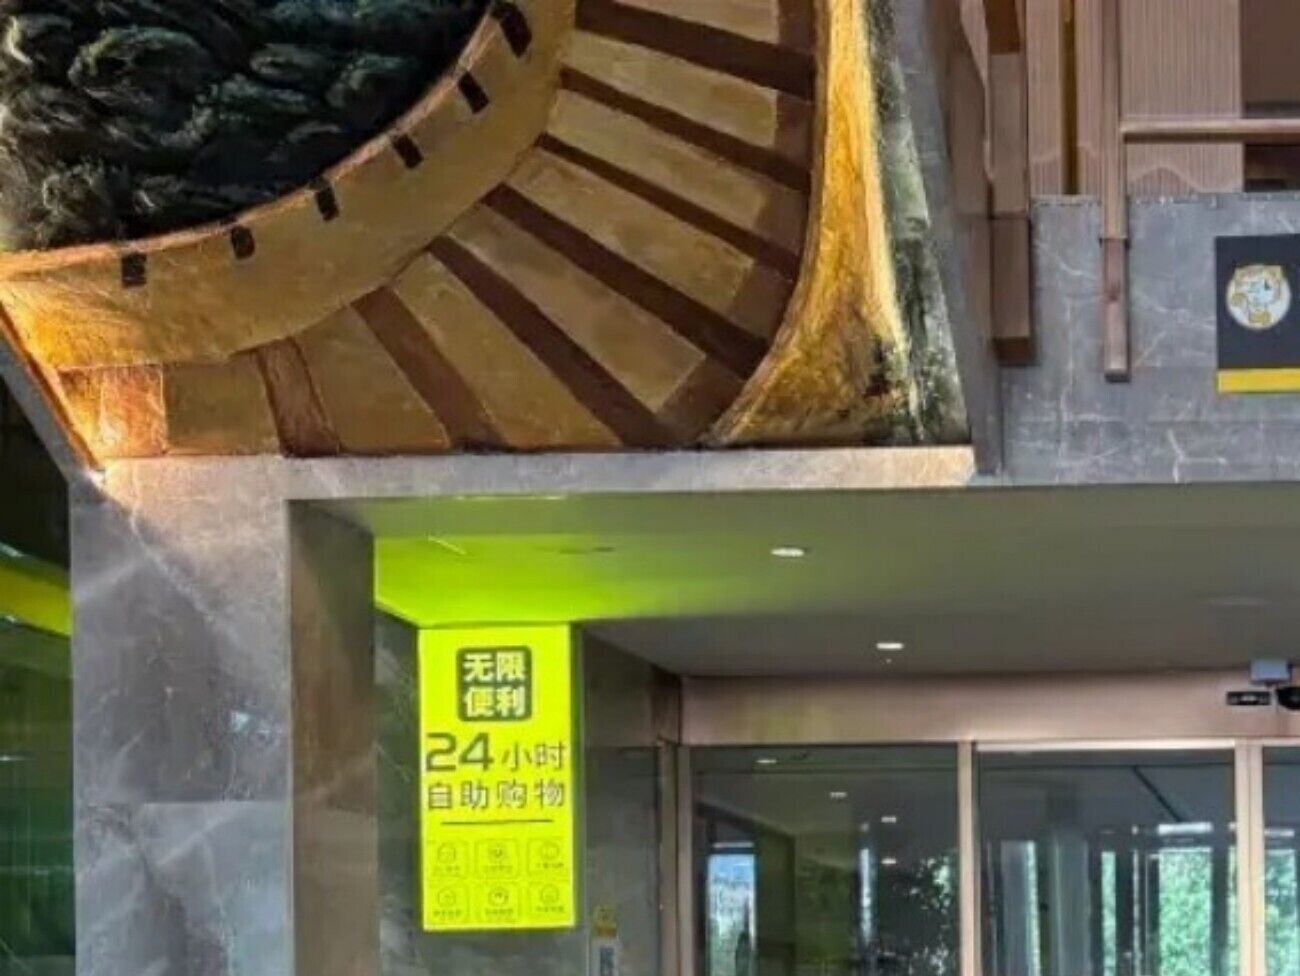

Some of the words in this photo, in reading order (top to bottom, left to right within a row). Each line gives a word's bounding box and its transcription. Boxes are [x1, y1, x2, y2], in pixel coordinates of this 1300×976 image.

[463, 652, 526, 682] 无限
[463, 686, 527, 718] 便利
[425, 733, 566, 773] 24小时
[427, 779, 566, 810] 自助购物
